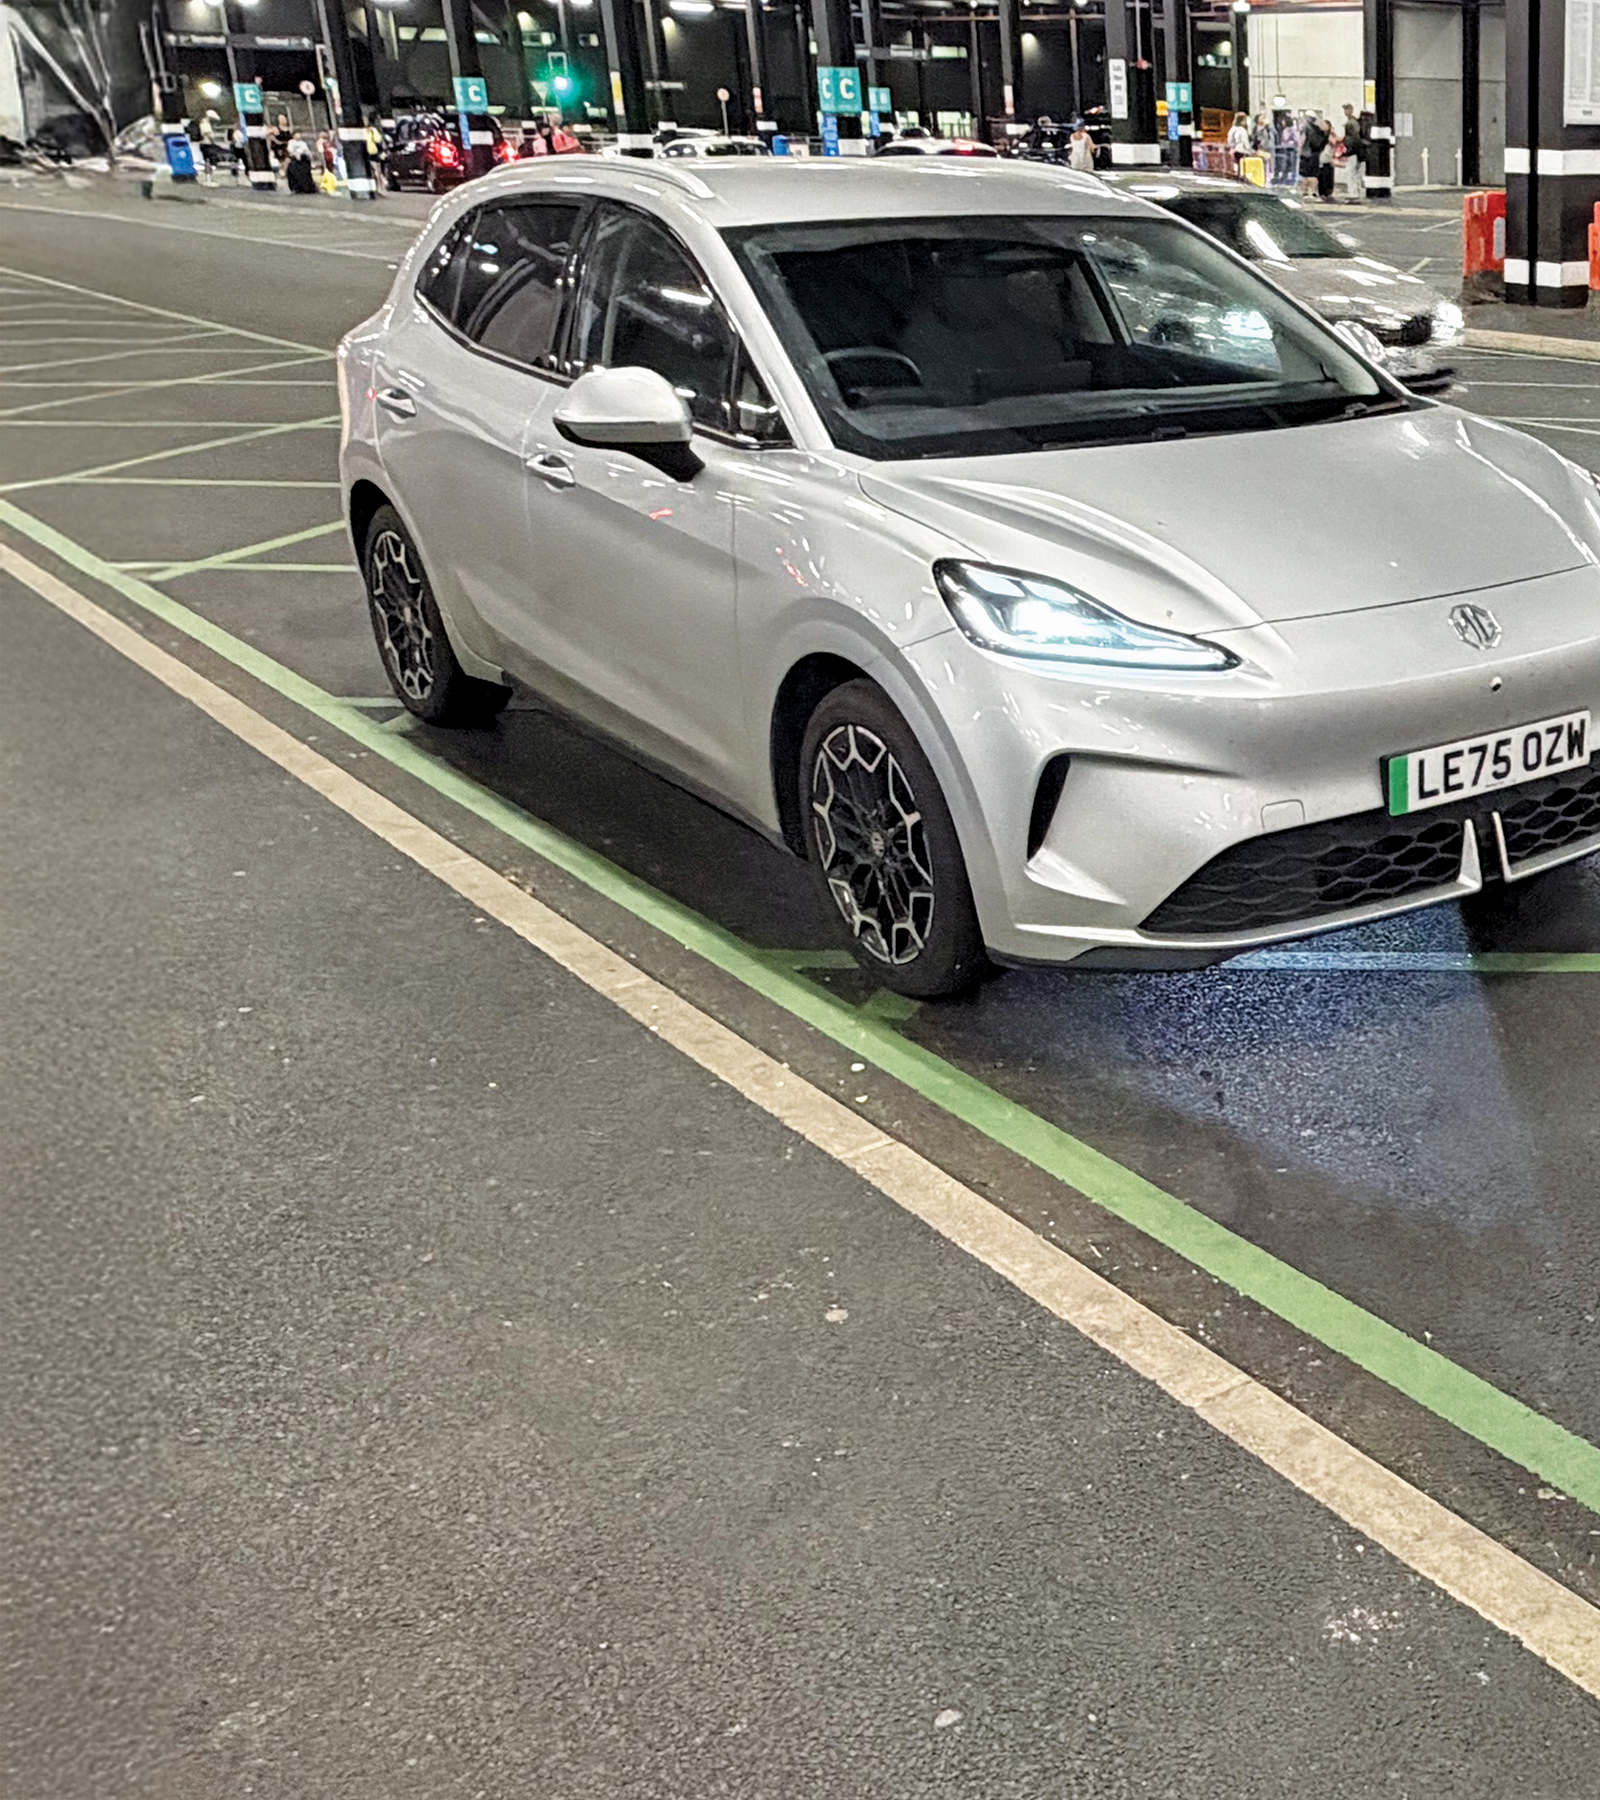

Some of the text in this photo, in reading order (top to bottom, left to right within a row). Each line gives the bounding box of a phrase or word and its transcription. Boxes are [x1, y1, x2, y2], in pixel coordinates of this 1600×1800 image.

[244, 89, 257, 103] C
[468, 85, 482, 101] C
[840, 78, 855, 99] C
[1418, 718, 1586, 800] LE75 OZW
